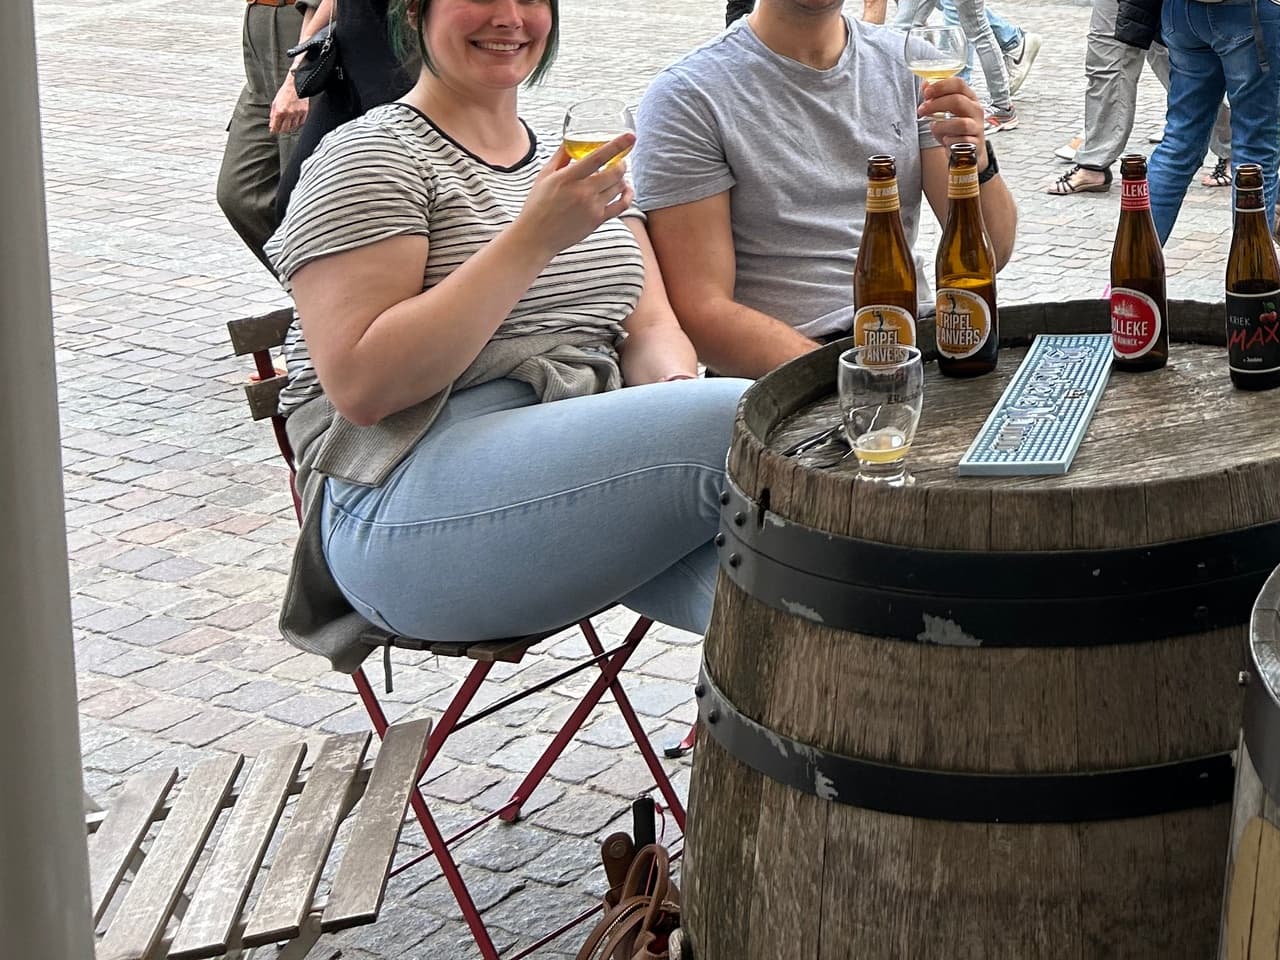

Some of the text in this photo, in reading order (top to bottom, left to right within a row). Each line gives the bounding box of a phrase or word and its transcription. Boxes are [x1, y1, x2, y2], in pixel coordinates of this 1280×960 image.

[939, 312, 973, 330] TRIPEL
[864, 330, 899, 346] TRIPEL
[1229, 321, 1280, 352] MAX
